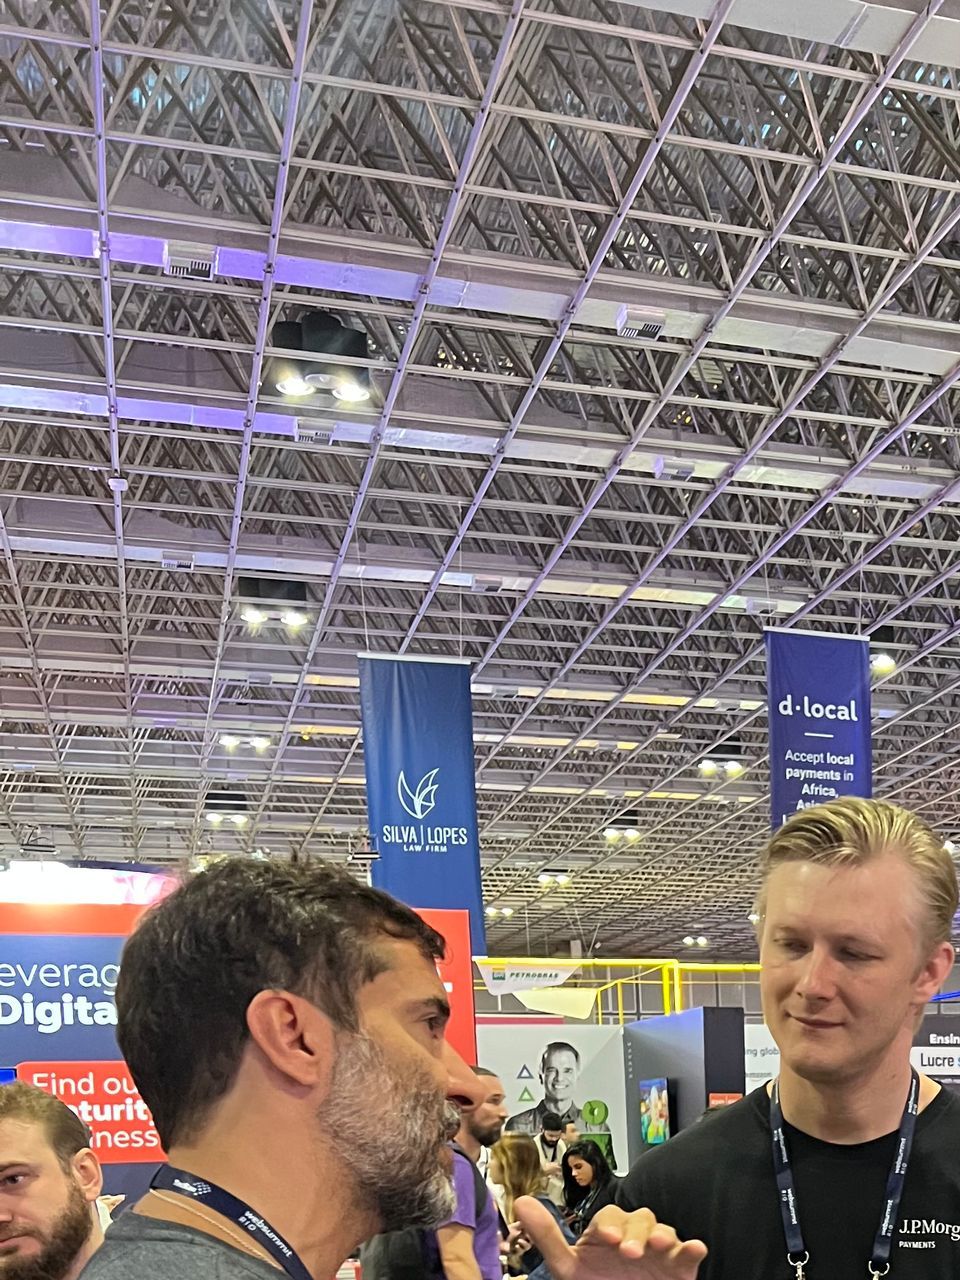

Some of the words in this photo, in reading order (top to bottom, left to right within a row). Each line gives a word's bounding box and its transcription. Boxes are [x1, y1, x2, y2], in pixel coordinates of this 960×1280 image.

[785, 749, 824, 765] Accept
[826, 752, 854, 766] local
[785, 767, 841, 781] payments
[843, 770, 854, 781] in
[801, 783, 839, 798] Africa,
[383, 825, 417, 843] SILVA
[427, 827, 468, 845] LOPES
[403, 844, 422, 852] LAW
[425, 845, 447, 853] FIRM
[920, 1052, 955, 1067] Lucre
[33, 1072, 95, 1095] Find
[237, 1216, 258, 1232] RIO
[244, 1210, 294, 1258] websummit
[898, 1240, 936, 1249] PAYMENTS
